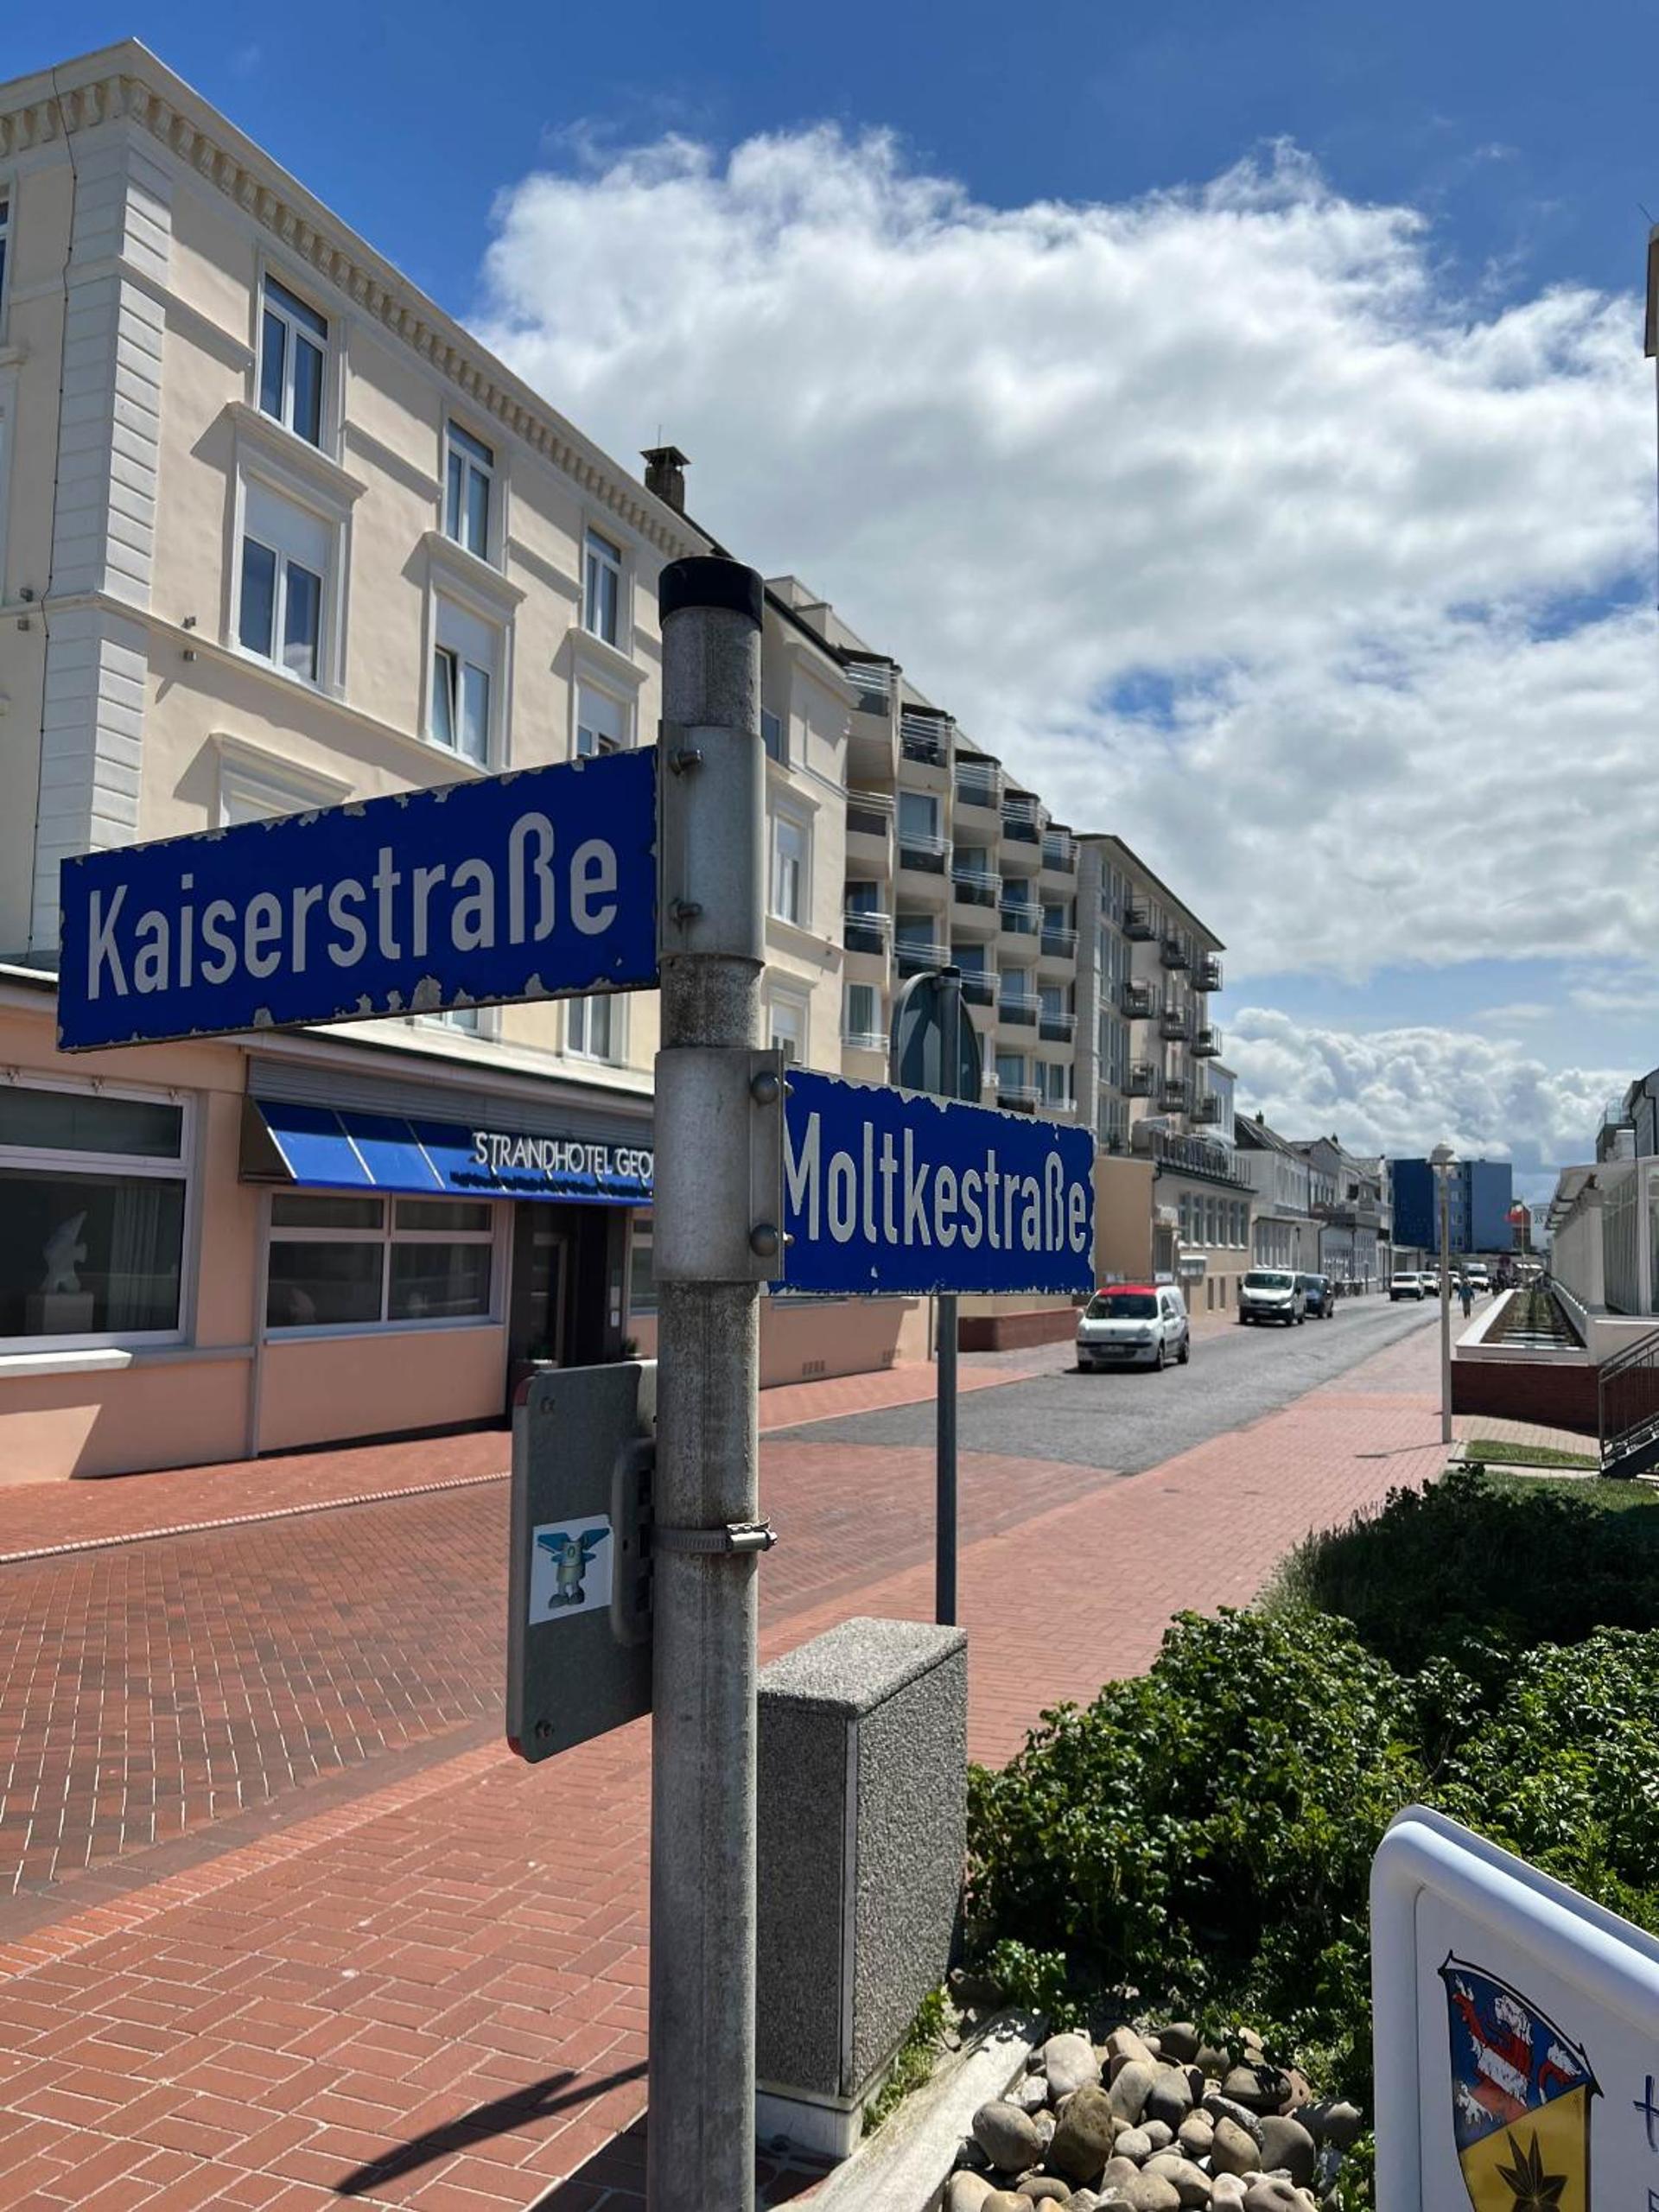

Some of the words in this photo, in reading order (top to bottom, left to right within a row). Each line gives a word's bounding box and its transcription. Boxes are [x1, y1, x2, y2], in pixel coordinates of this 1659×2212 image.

[87, 811, 618, 1001] Kaiserstraße
[473, 1131, 613, 1174] STRANDHOTEL
[614, 1147, 654, 1181] GEO
[784, 1112, 1086, 1253] Moltkestraße
